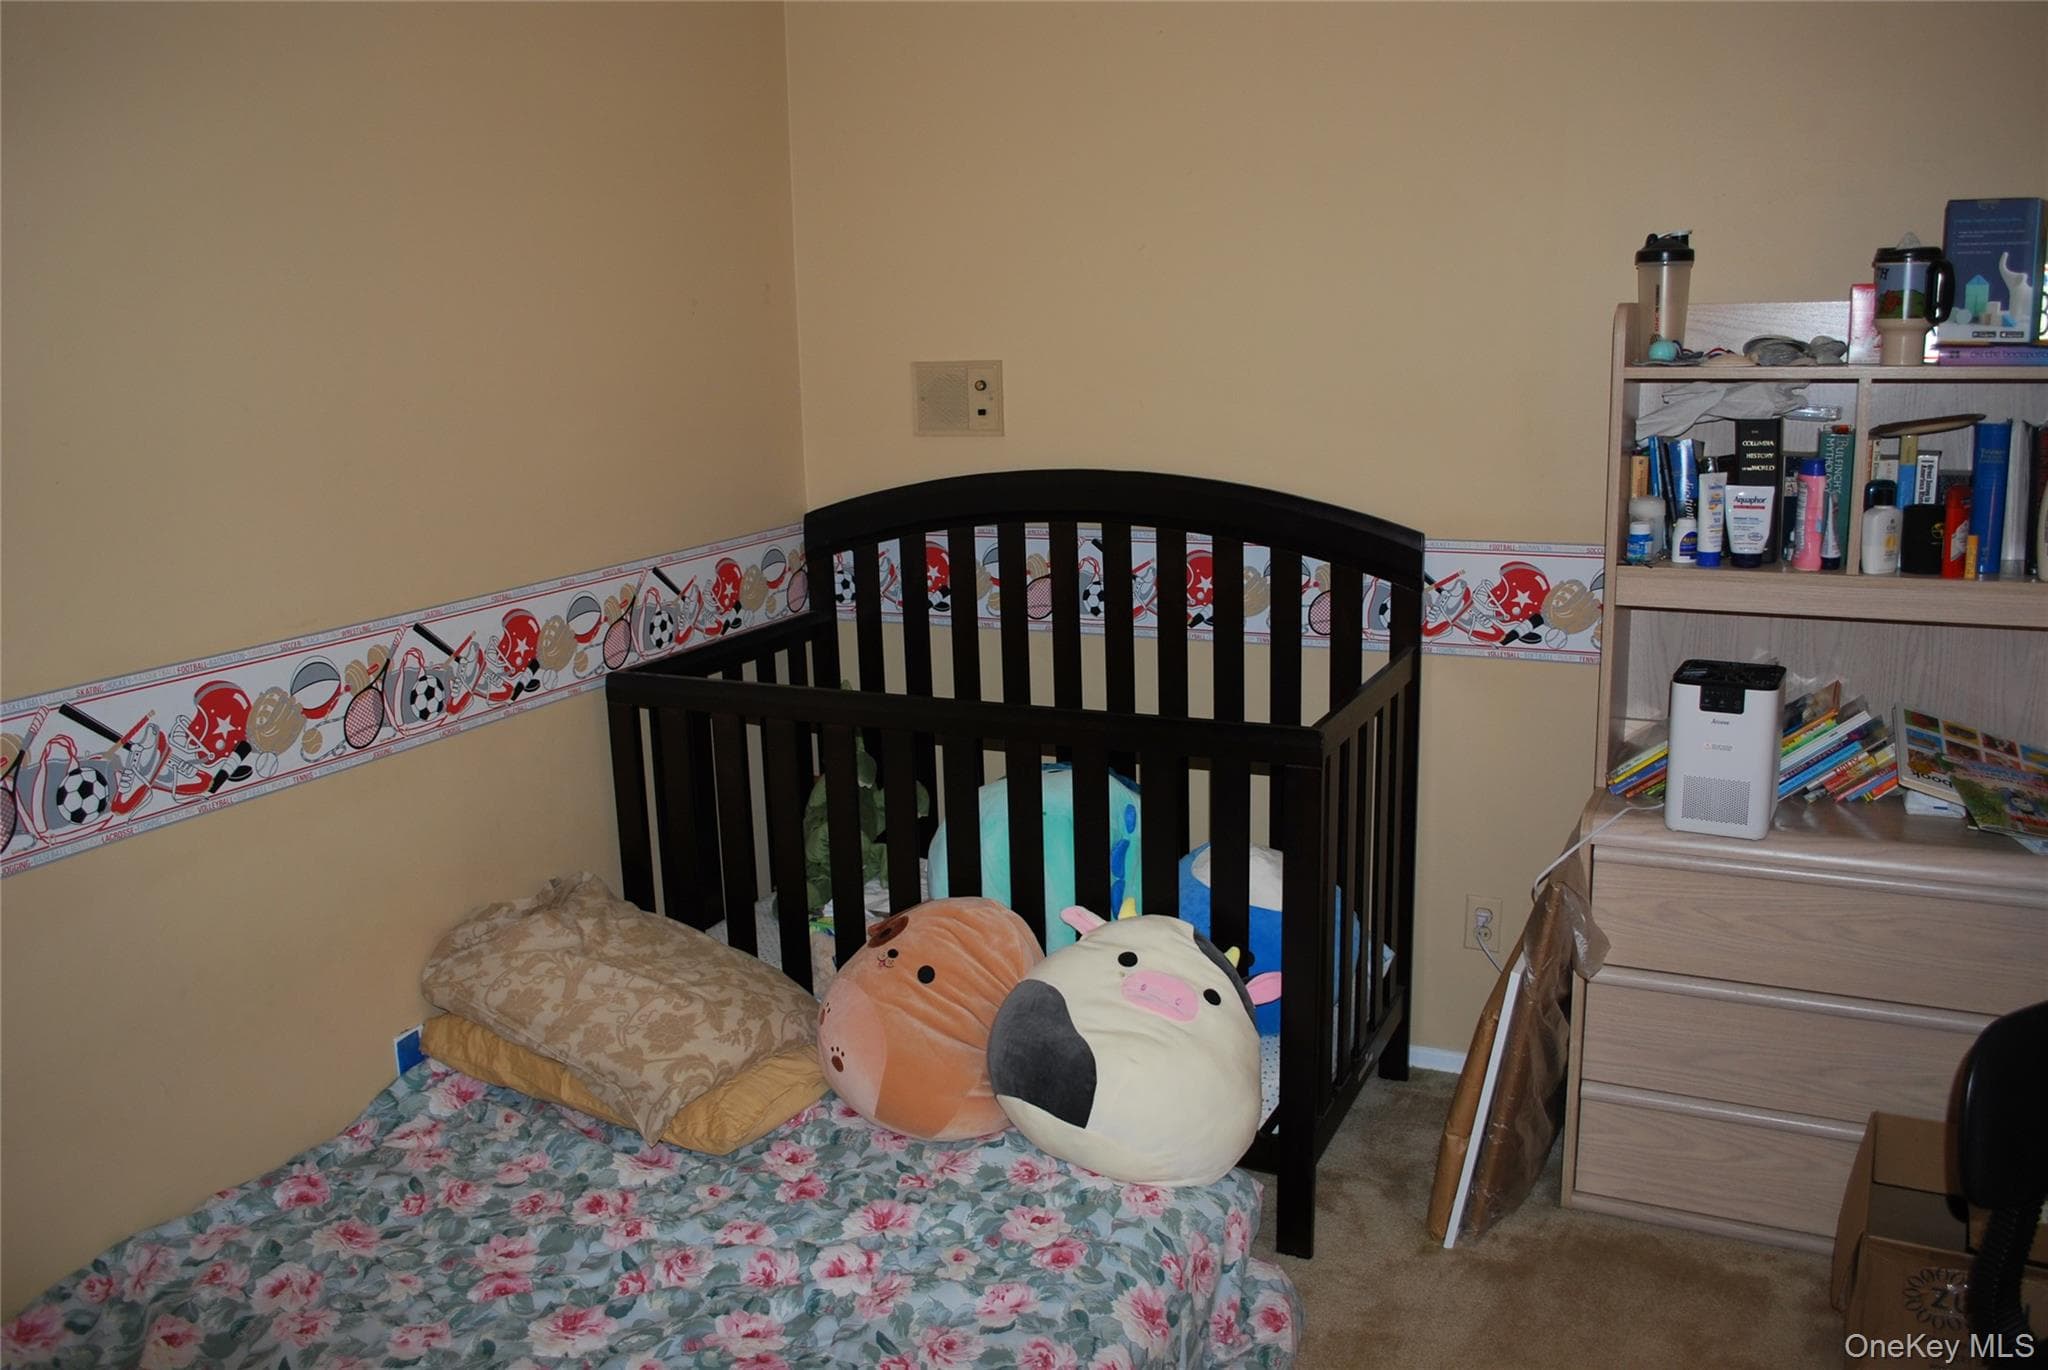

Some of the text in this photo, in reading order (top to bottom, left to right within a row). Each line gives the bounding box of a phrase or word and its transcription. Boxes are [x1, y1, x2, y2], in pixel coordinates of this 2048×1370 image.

[1745, 452, 1775, 460] HISTORY
[1734, 496, 1767, 505] Aquaphor
[1489, 543, 1515, 551] FOOTBALL
[1487, 650, 1520, 659] VOLLEYBALL
[1, 695, 46, 711] ASKETBALL
[76, 684, 105, 697] SKATING
[177, 661, 208, 675] FOOTBALL
[279, 640, 302, 653] SOCCER
[101, 827, 136, 844] LACROSSE
[197, 796, 235, 815] VOLLEYBALL
[292, 770, 314, 784] TENNIS
